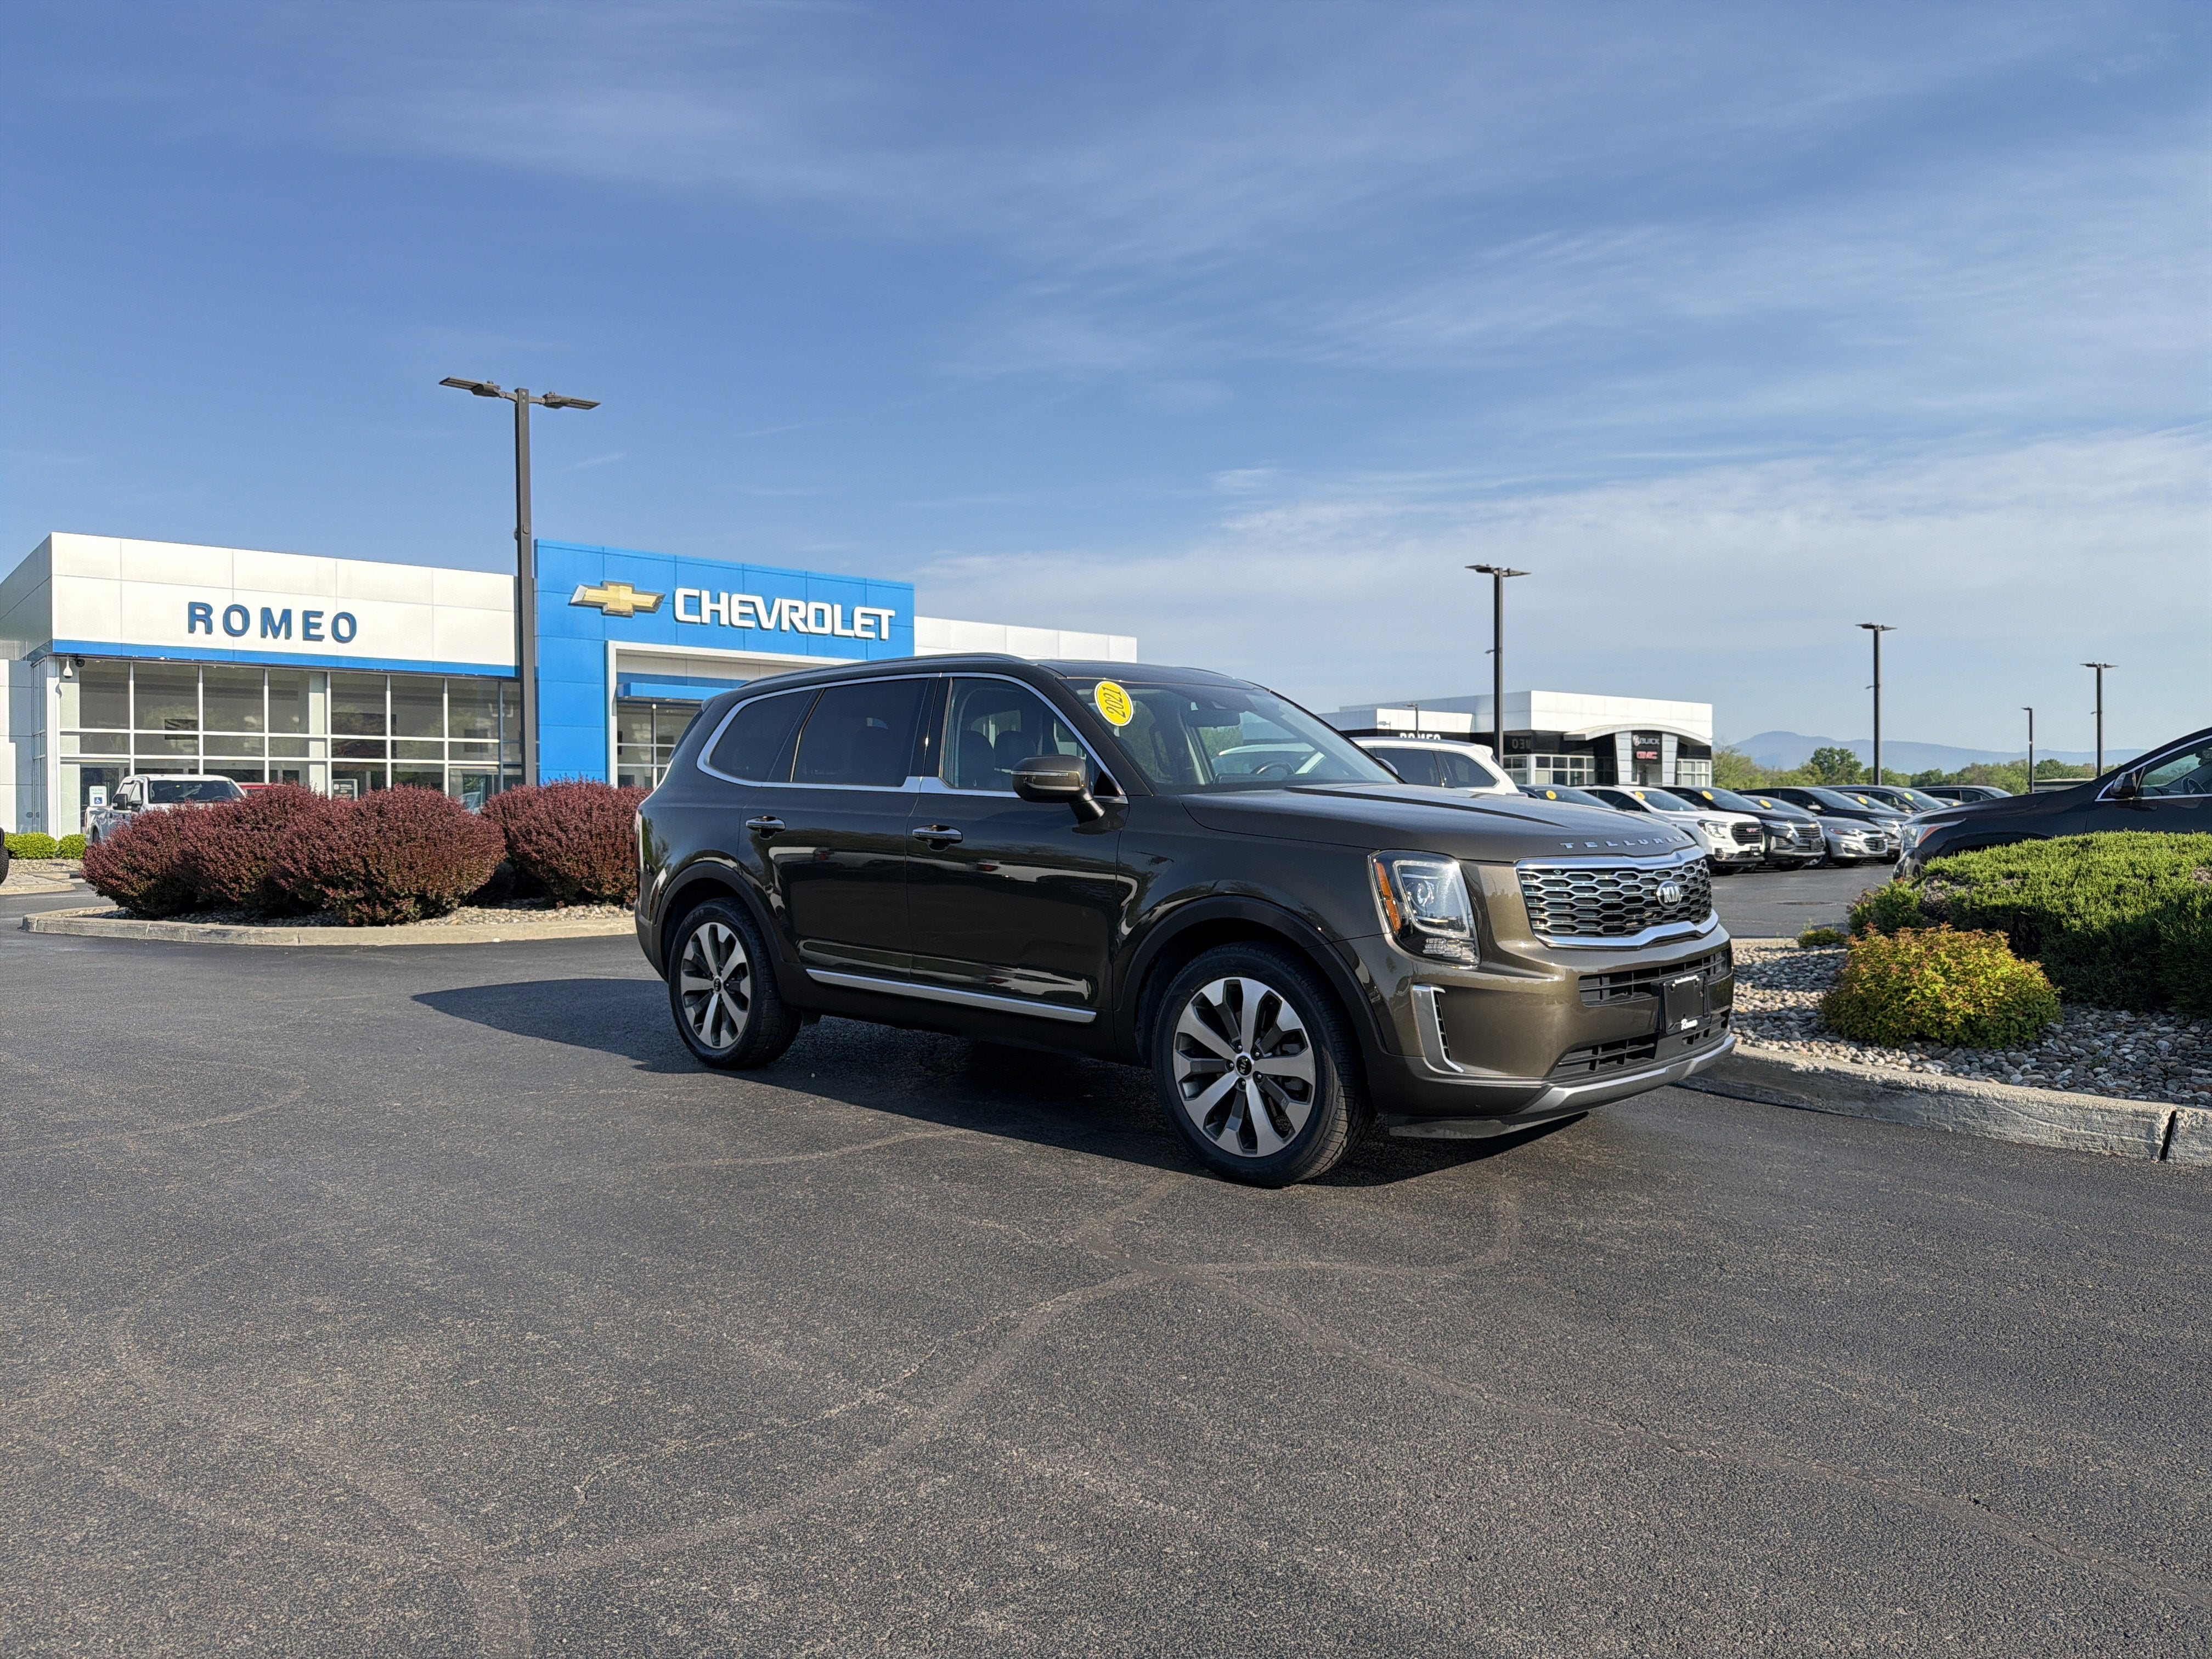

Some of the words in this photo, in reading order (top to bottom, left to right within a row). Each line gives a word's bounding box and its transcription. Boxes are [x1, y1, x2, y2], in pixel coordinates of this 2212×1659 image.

[188, 601, 357, 644] ROMEO
[674, 588, 895, 641] CHEVROLET
[1101, 686, 1126, 718] 2021
[1636, 751, 1658, 760] GMC
[1662, 885, 1680, 903] KIA
[1239, 1058, 1248, 1074] KIA
